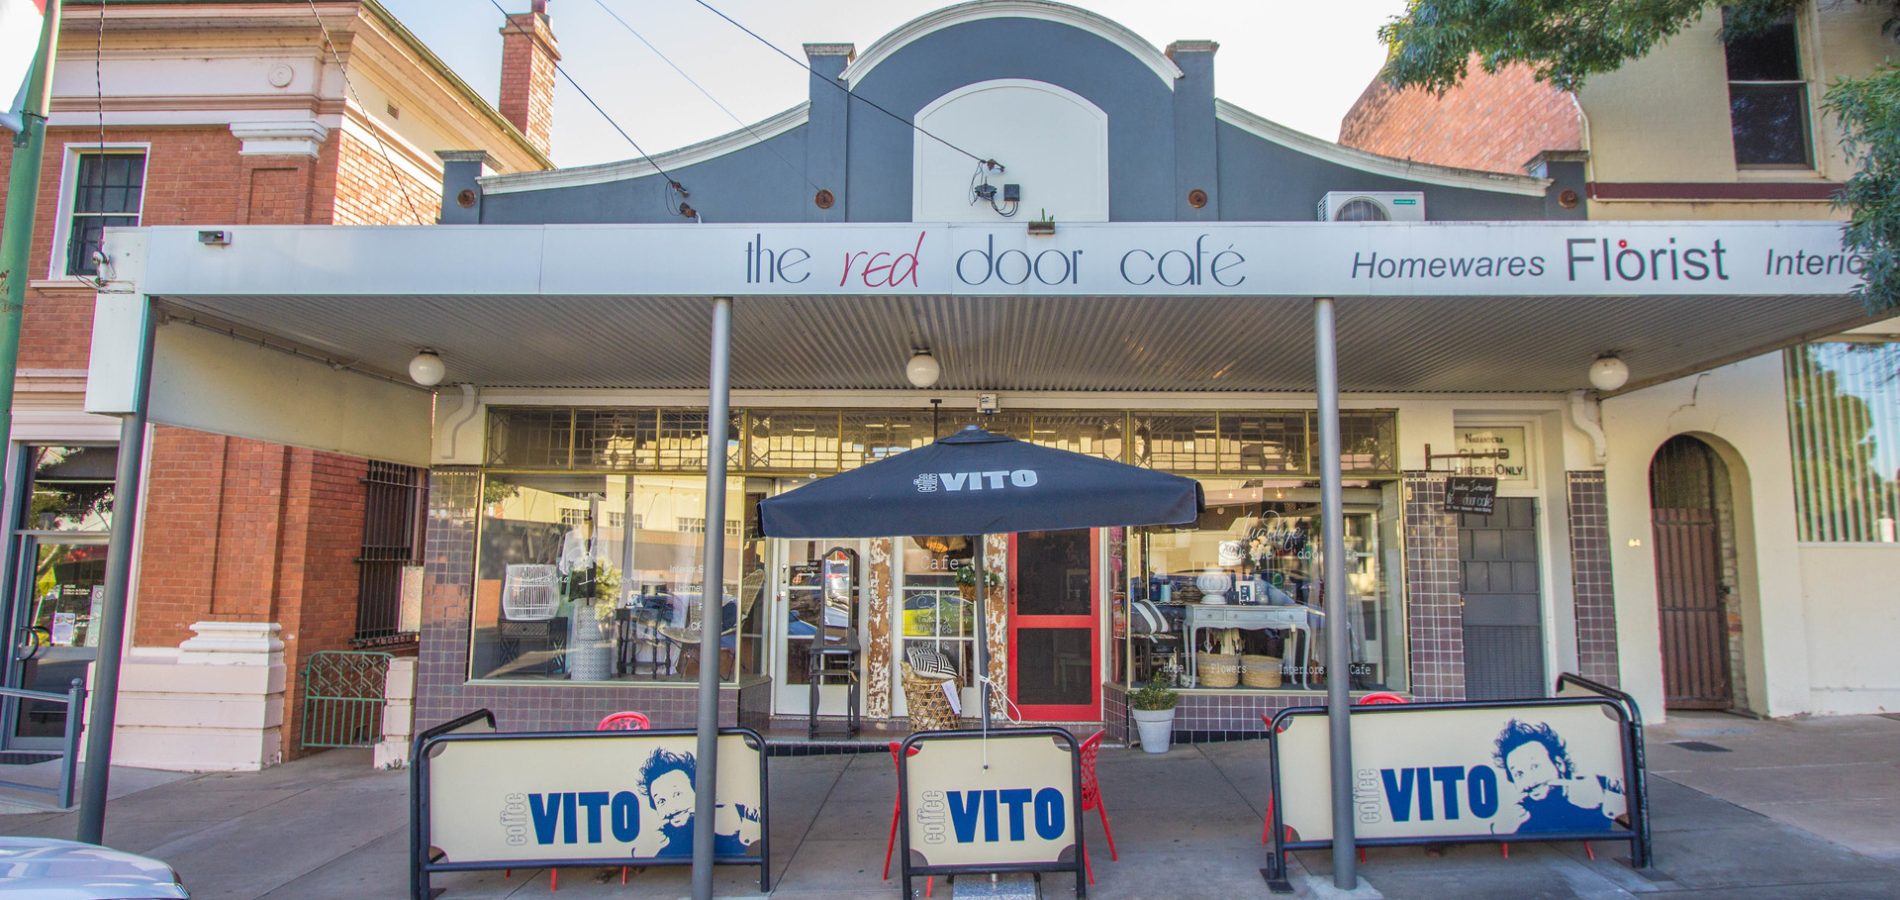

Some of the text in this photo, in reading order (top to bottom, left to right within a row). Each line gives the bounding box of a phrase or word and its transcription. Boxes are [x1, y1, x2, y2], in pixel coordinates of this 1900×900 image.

[745, 231, 1247, 288] the red door café
[1351, 238, 1866, 281] Homewares Florist Interio
[938, 469, 1038, 491] VITO
[921, 554, 959, 570] Cafe
[1297, 549, 1319, 560] doo
[1350, 664, 1371, 674] Cafe
[1380, 764, 1499, 822] VITO
[528, 791, 639, 845] VITO
[946, 787, 1065, 843] VITO
